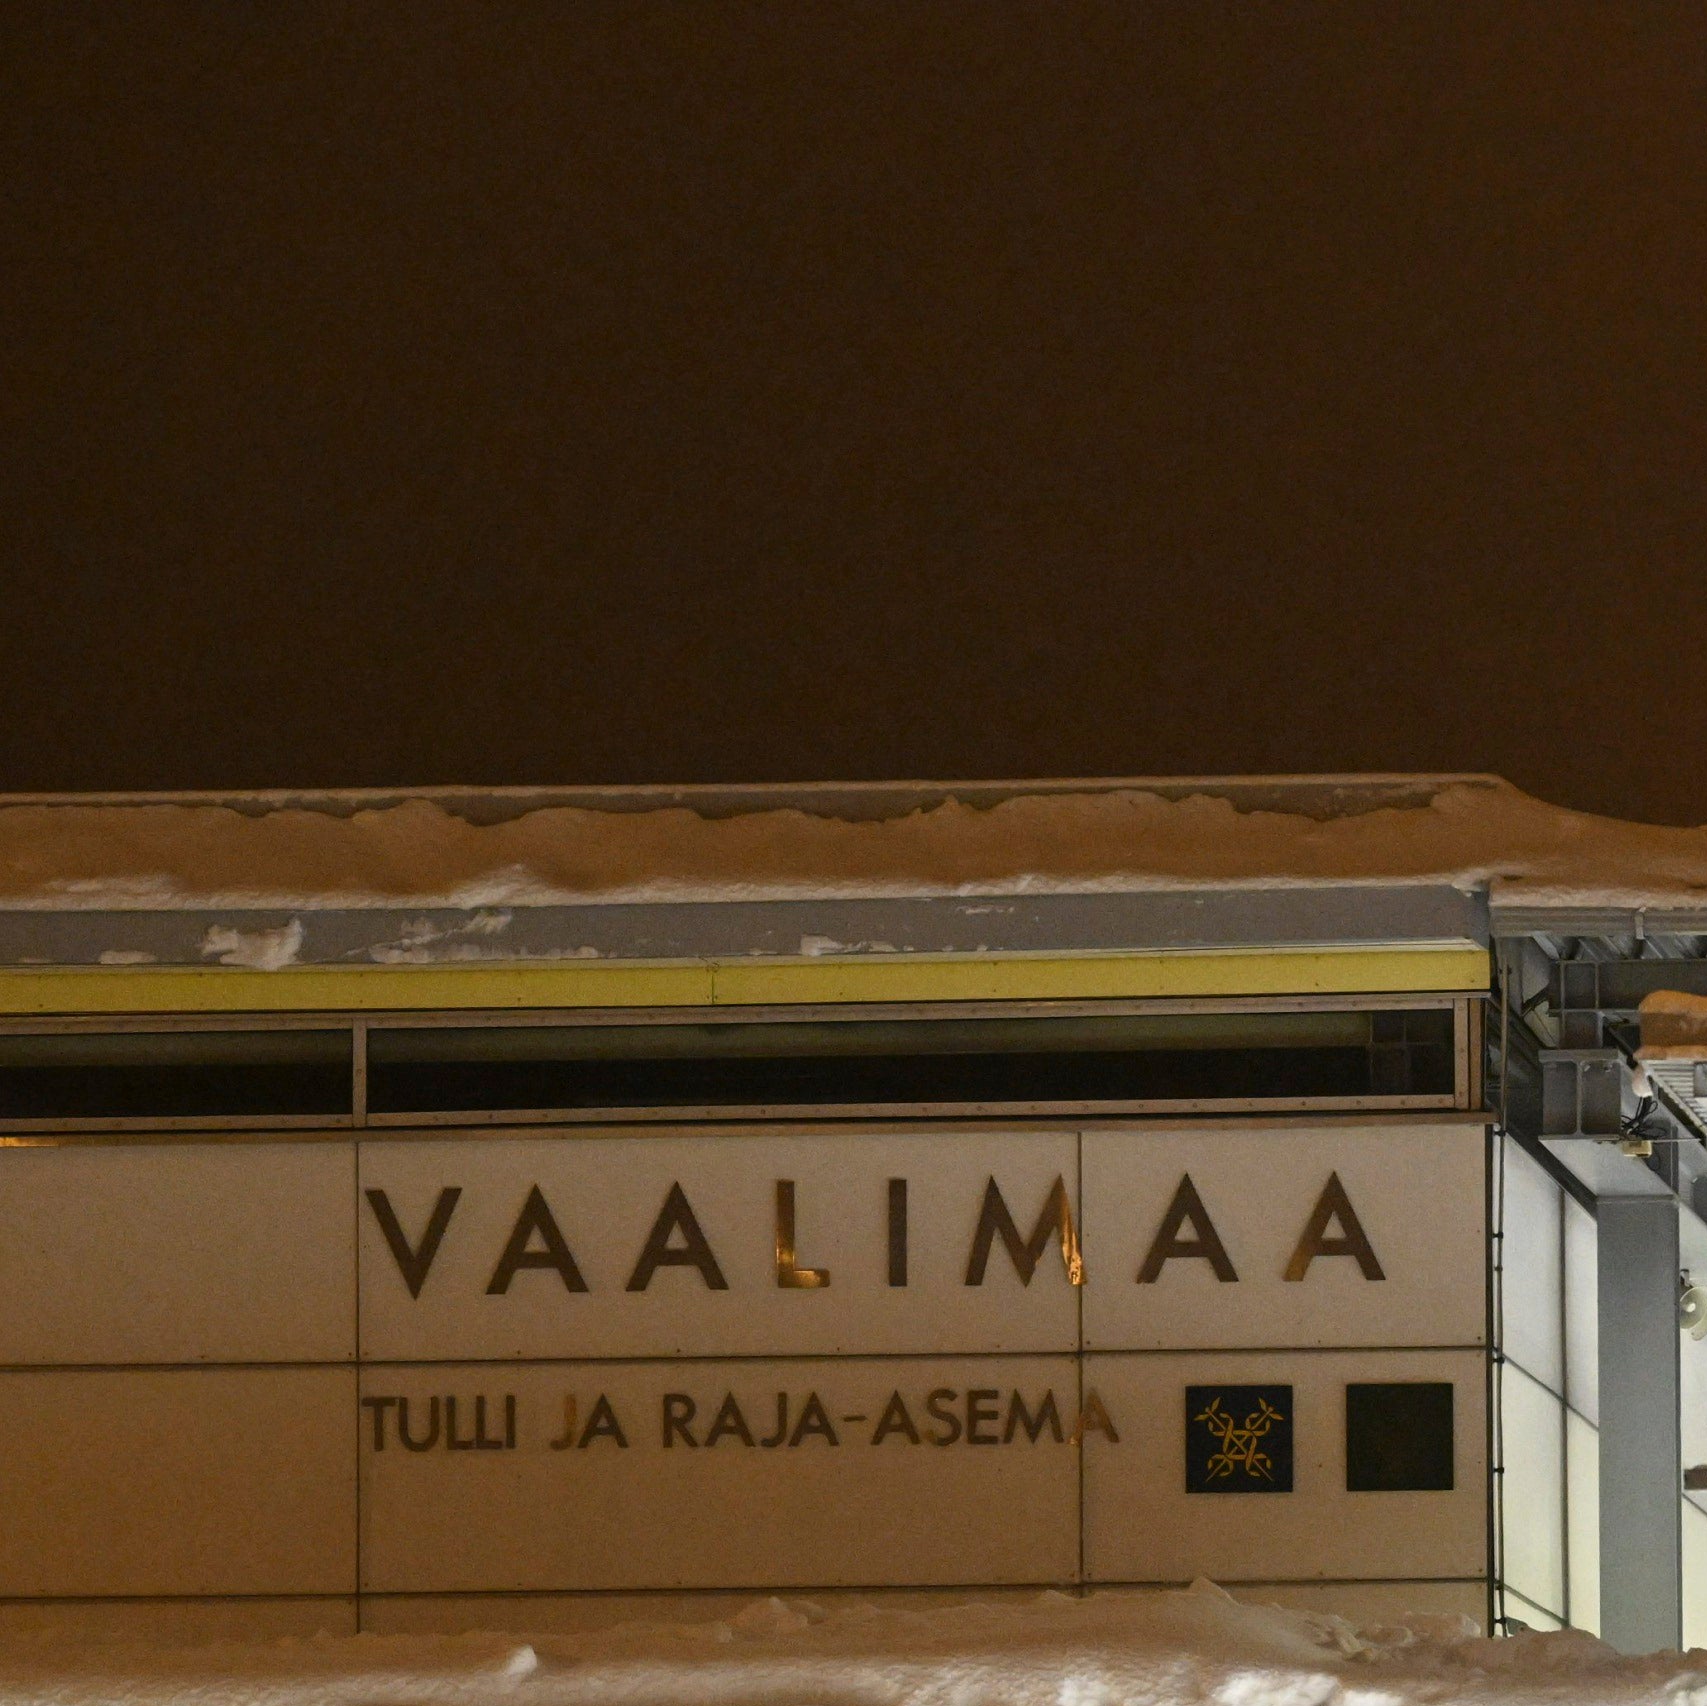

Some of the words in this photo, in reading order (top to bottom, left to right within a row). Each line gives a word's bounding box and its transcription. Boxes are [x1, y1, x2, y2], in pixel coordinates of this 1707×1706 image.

[365, 1170, 1388, 1299] VAALIMAA
[361, 1396, 516, 1453] TULLI
[549, 1394, 627, 1451] JA
[661, 1388, 1120, 1449] RAJA-ASEMA
